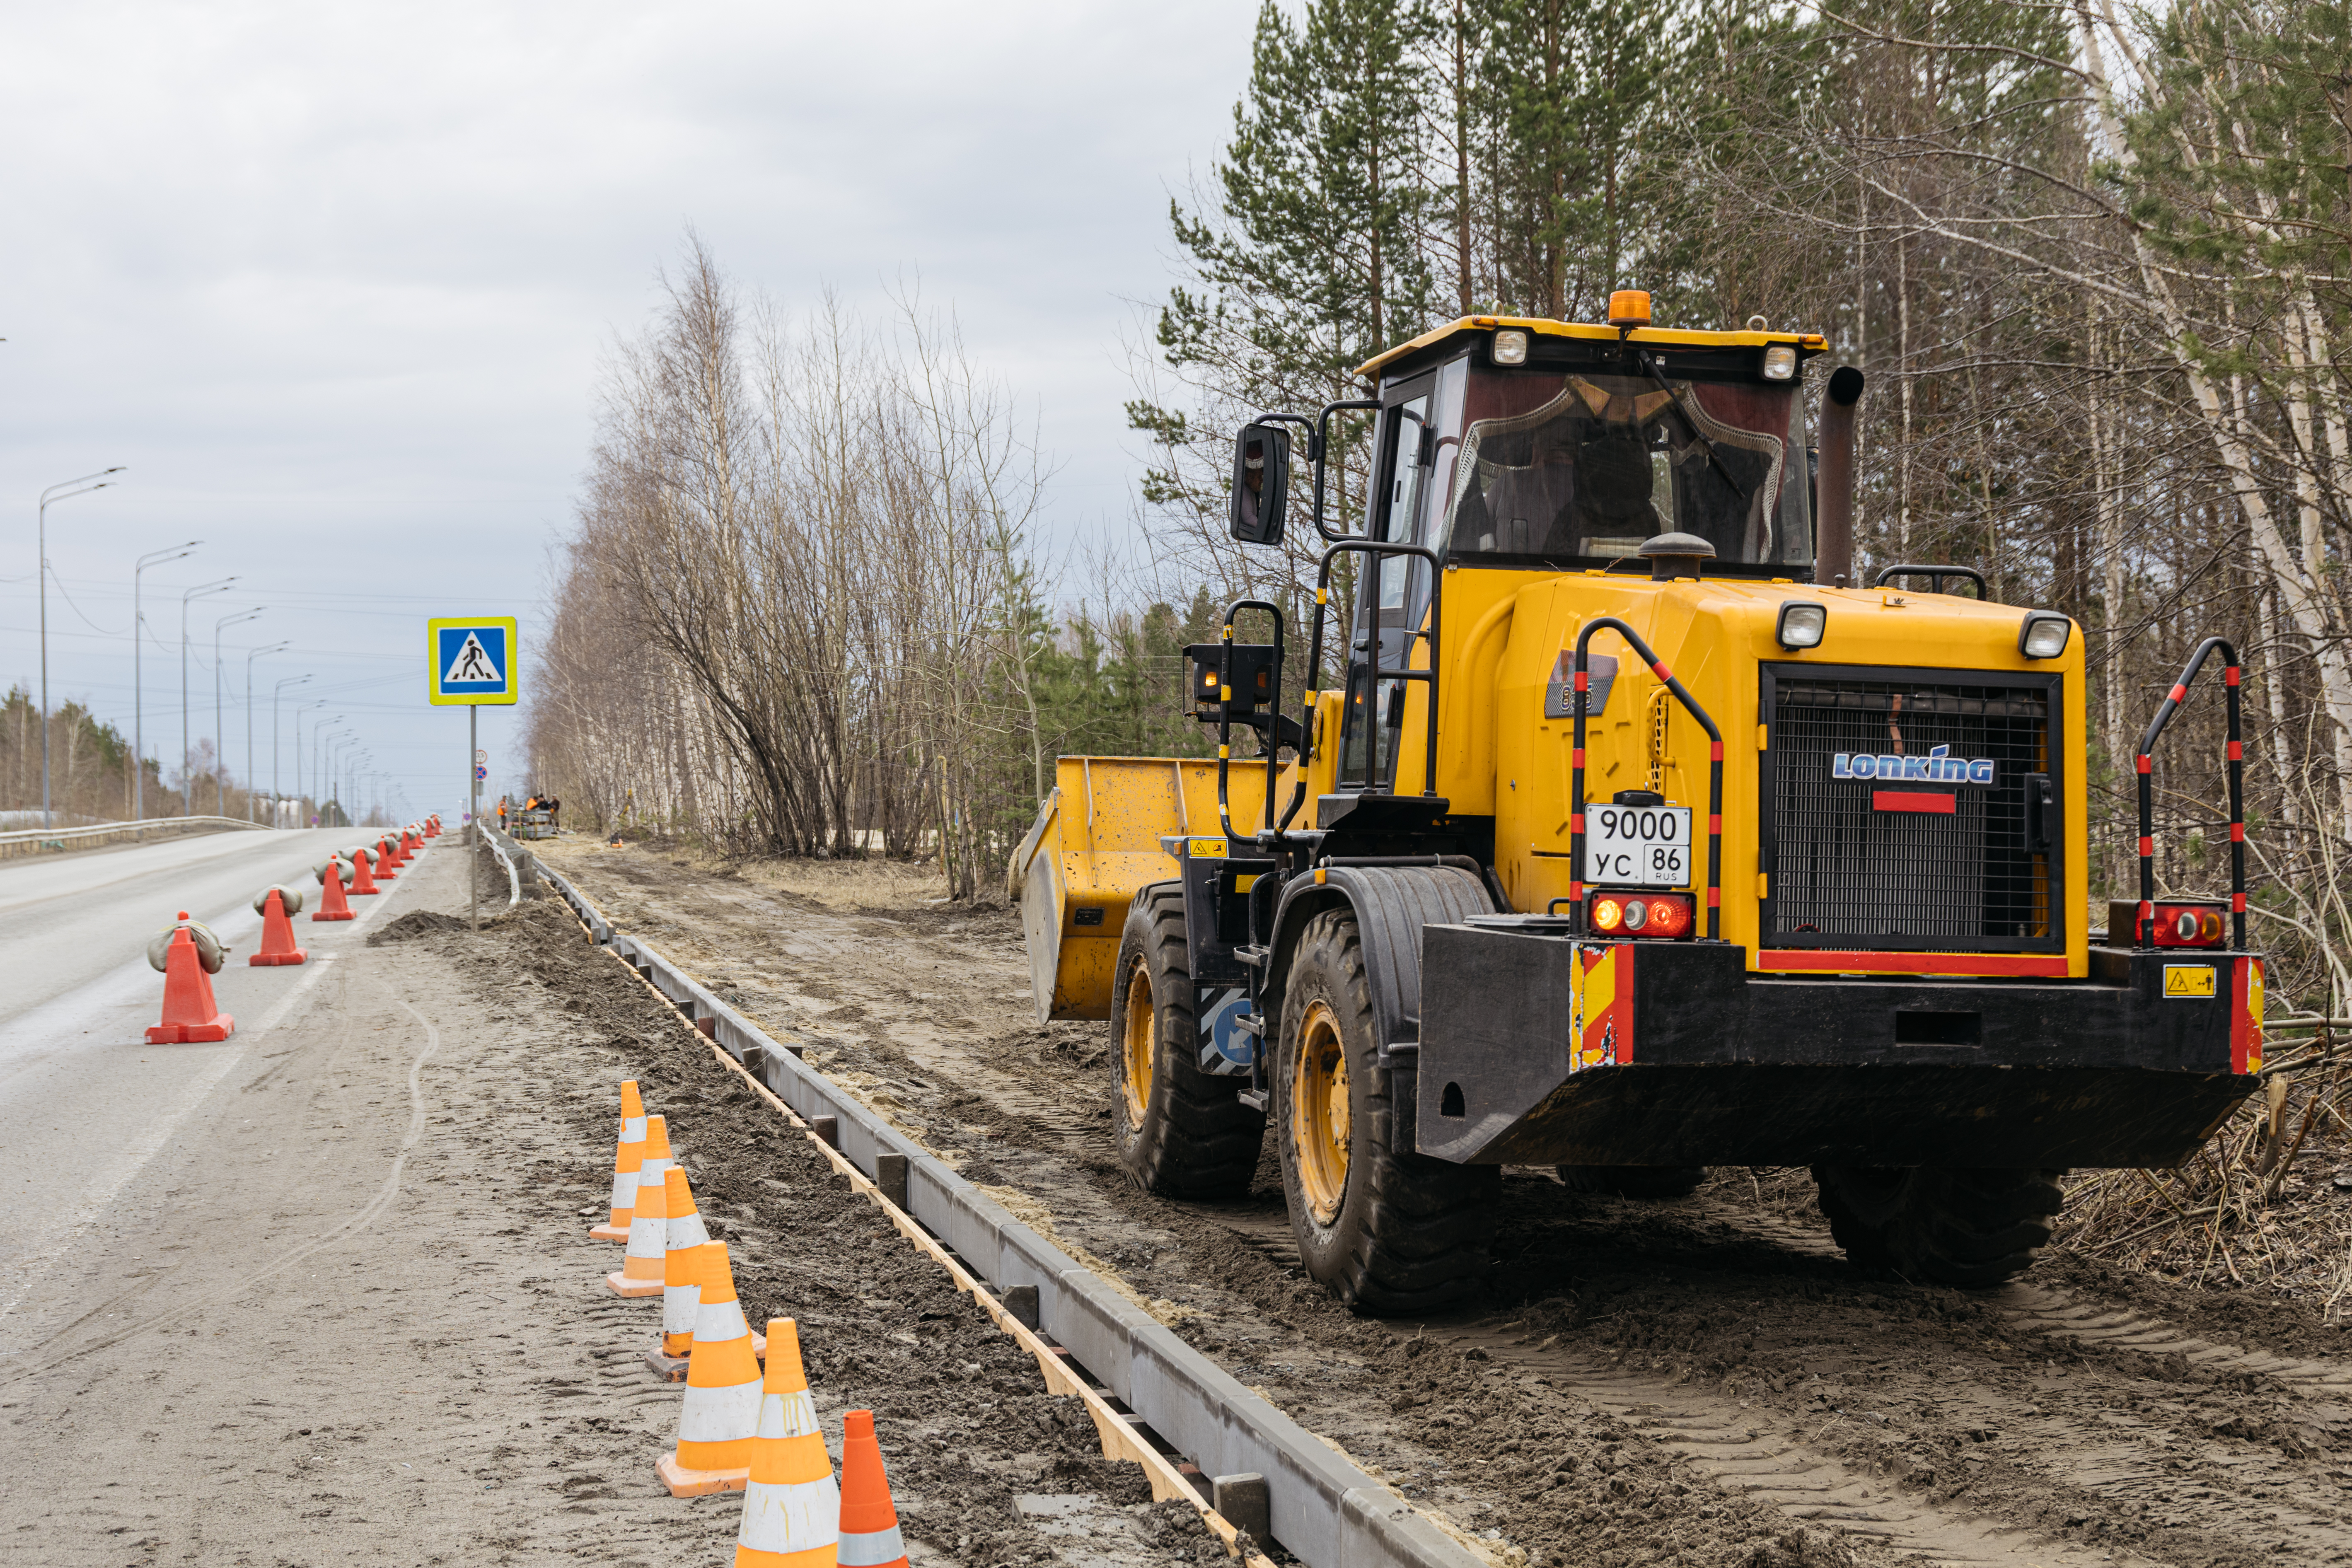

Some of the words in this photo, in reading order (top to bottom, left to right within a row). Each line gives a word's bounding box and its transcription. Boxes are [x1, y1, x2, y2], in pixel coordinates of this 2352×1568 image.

[1600, 810, 1676, 841] 9000
[1652, 848, 1681, 871] 86
[1656, 872, 1677, 881] RUS
